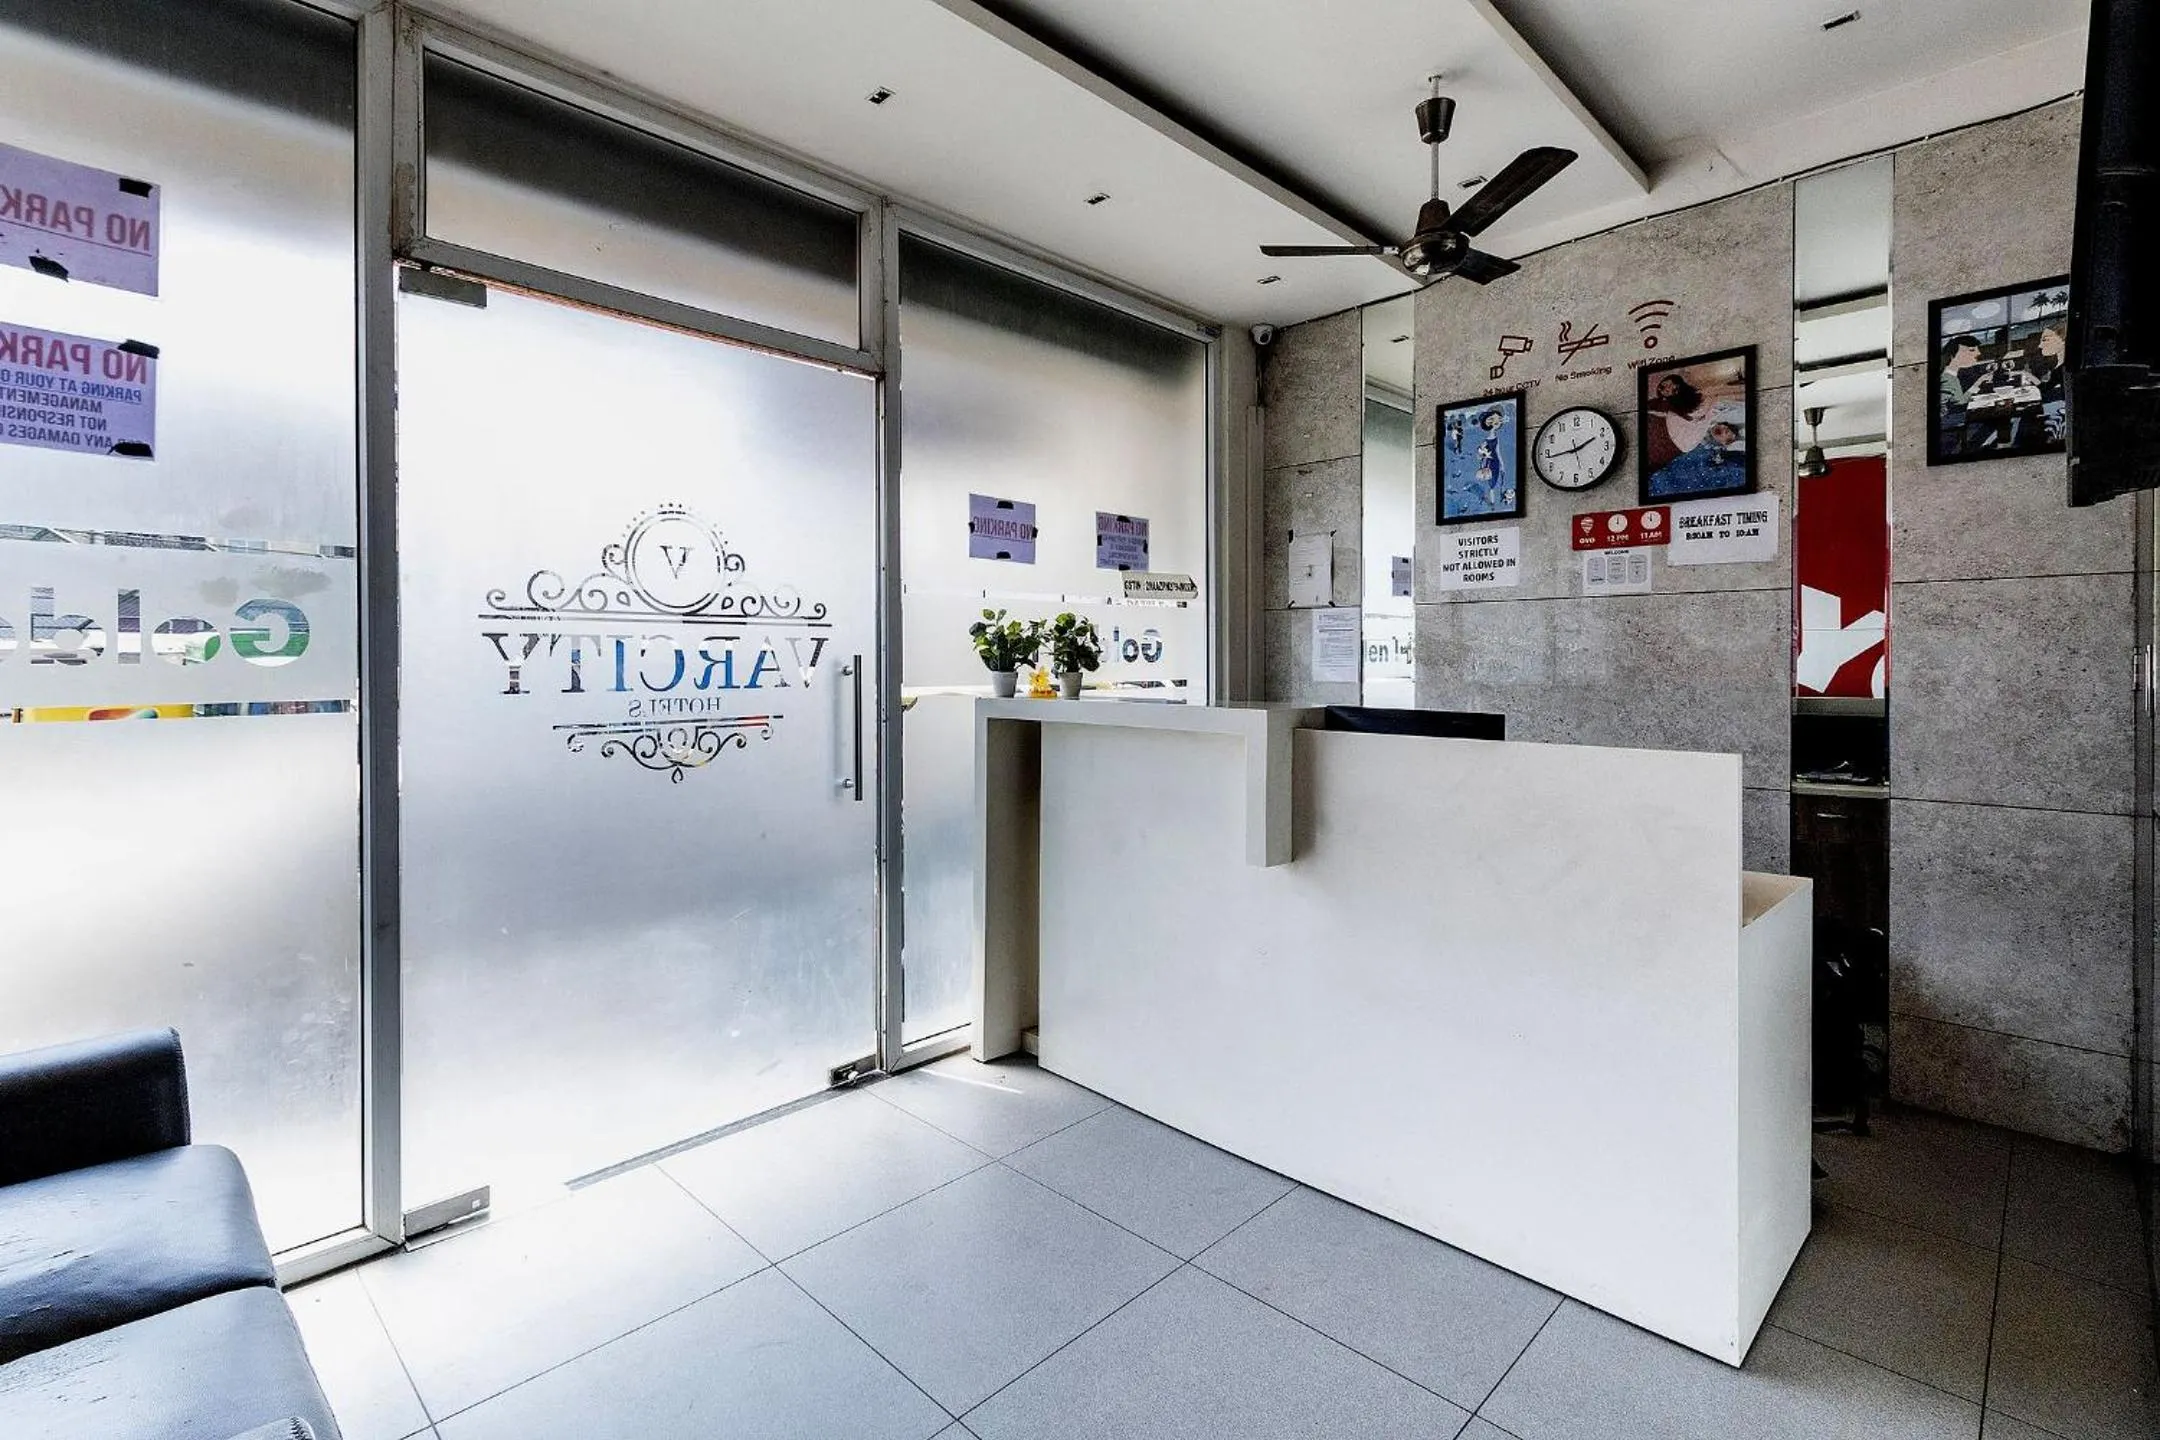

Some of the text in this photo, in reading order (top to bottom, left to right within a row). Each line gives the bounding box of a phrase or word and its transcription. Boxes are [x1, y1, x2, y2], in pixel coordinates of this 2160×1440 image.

[1555, 367, 1613, 382] No Smoking
[1603, 441, 1609, 451] 3
[1679, 510, 1768, 529] BREAKFAST TIMING
[1719, 529, 1731, 539] TO
[1458, 535, 1499, 547] VISITORS
[1458, 547, 1499, 559] STRICTLY
[1443, 557, 1516, 573] NOT ALLOWED IN
[1463, 572, 1495, 582] ROOMS
